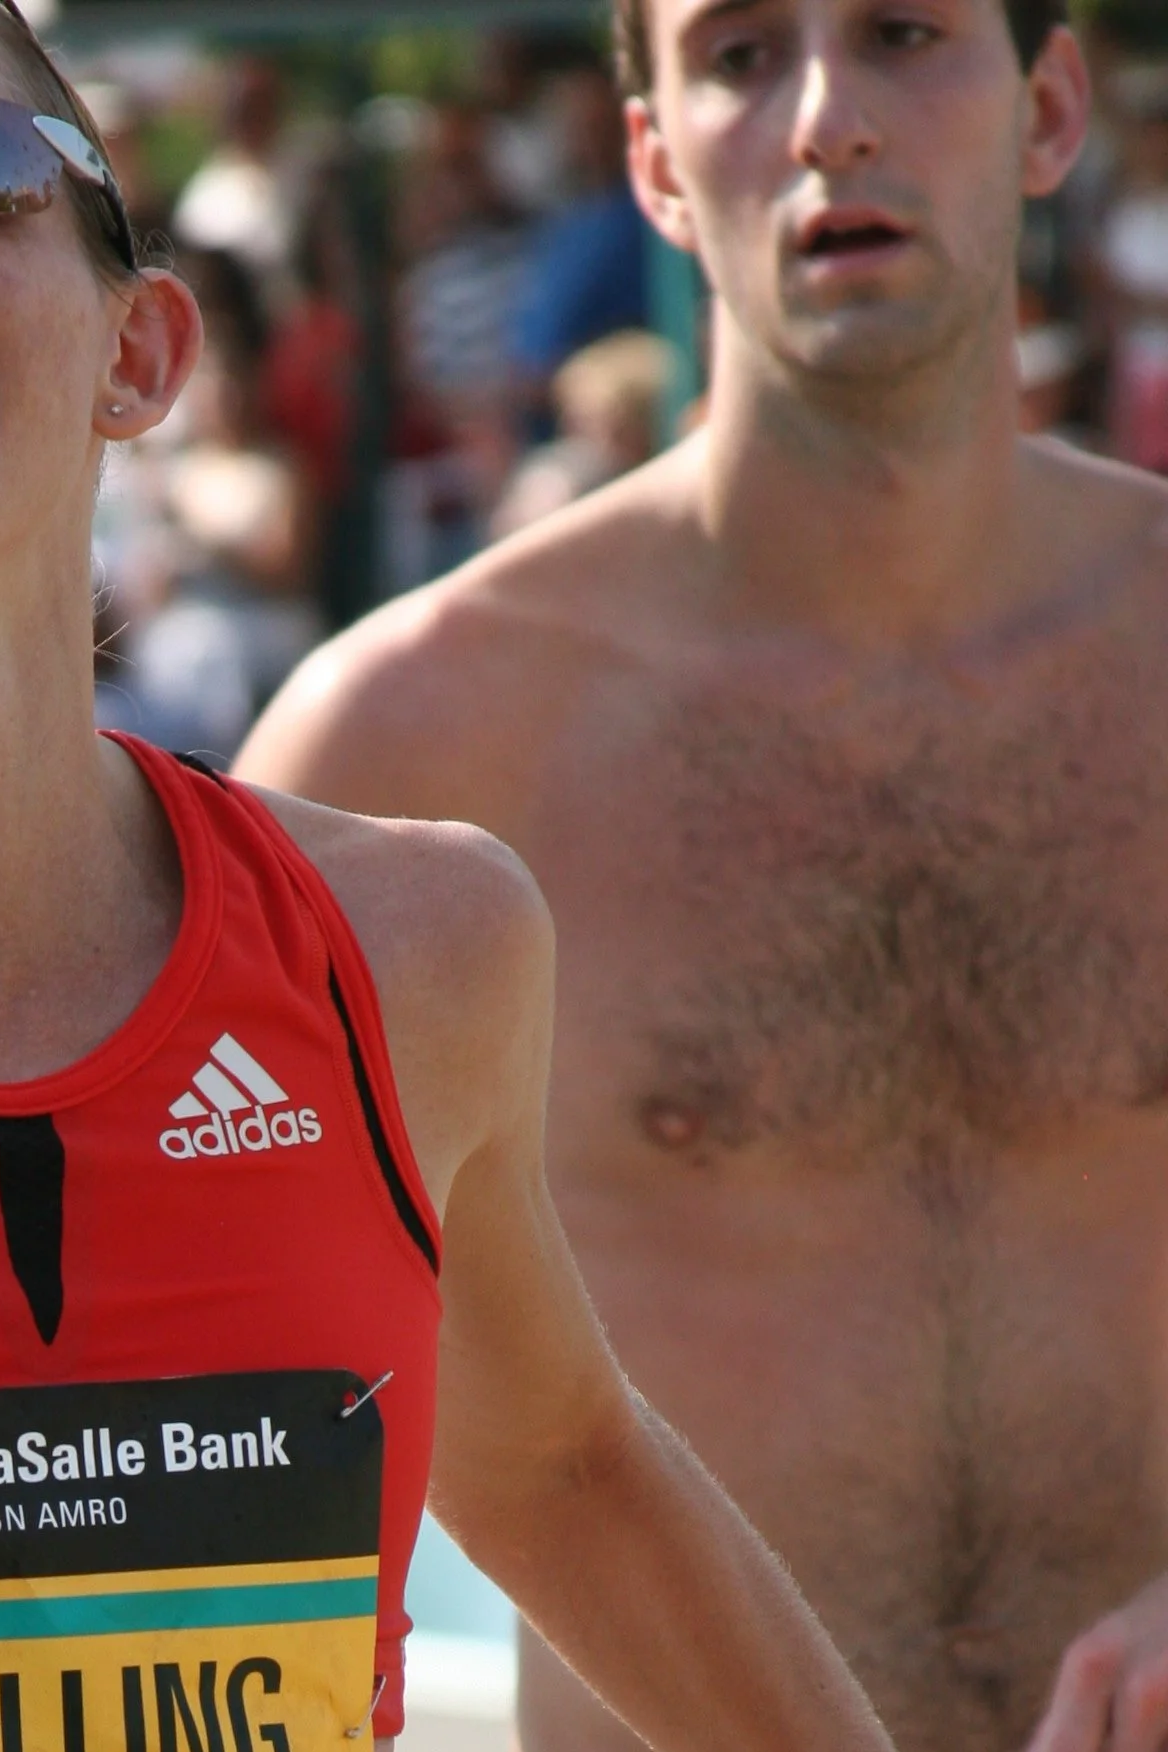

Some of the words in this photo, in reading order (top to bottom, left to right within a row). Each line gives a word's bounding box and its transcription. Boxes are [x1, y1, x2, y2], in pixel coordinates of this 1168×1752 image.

[158, 1104, 323, 1160] adidas
[161, 1416, 291, 1473] Bank
[38, 1497, 128, 1530] AMRO
